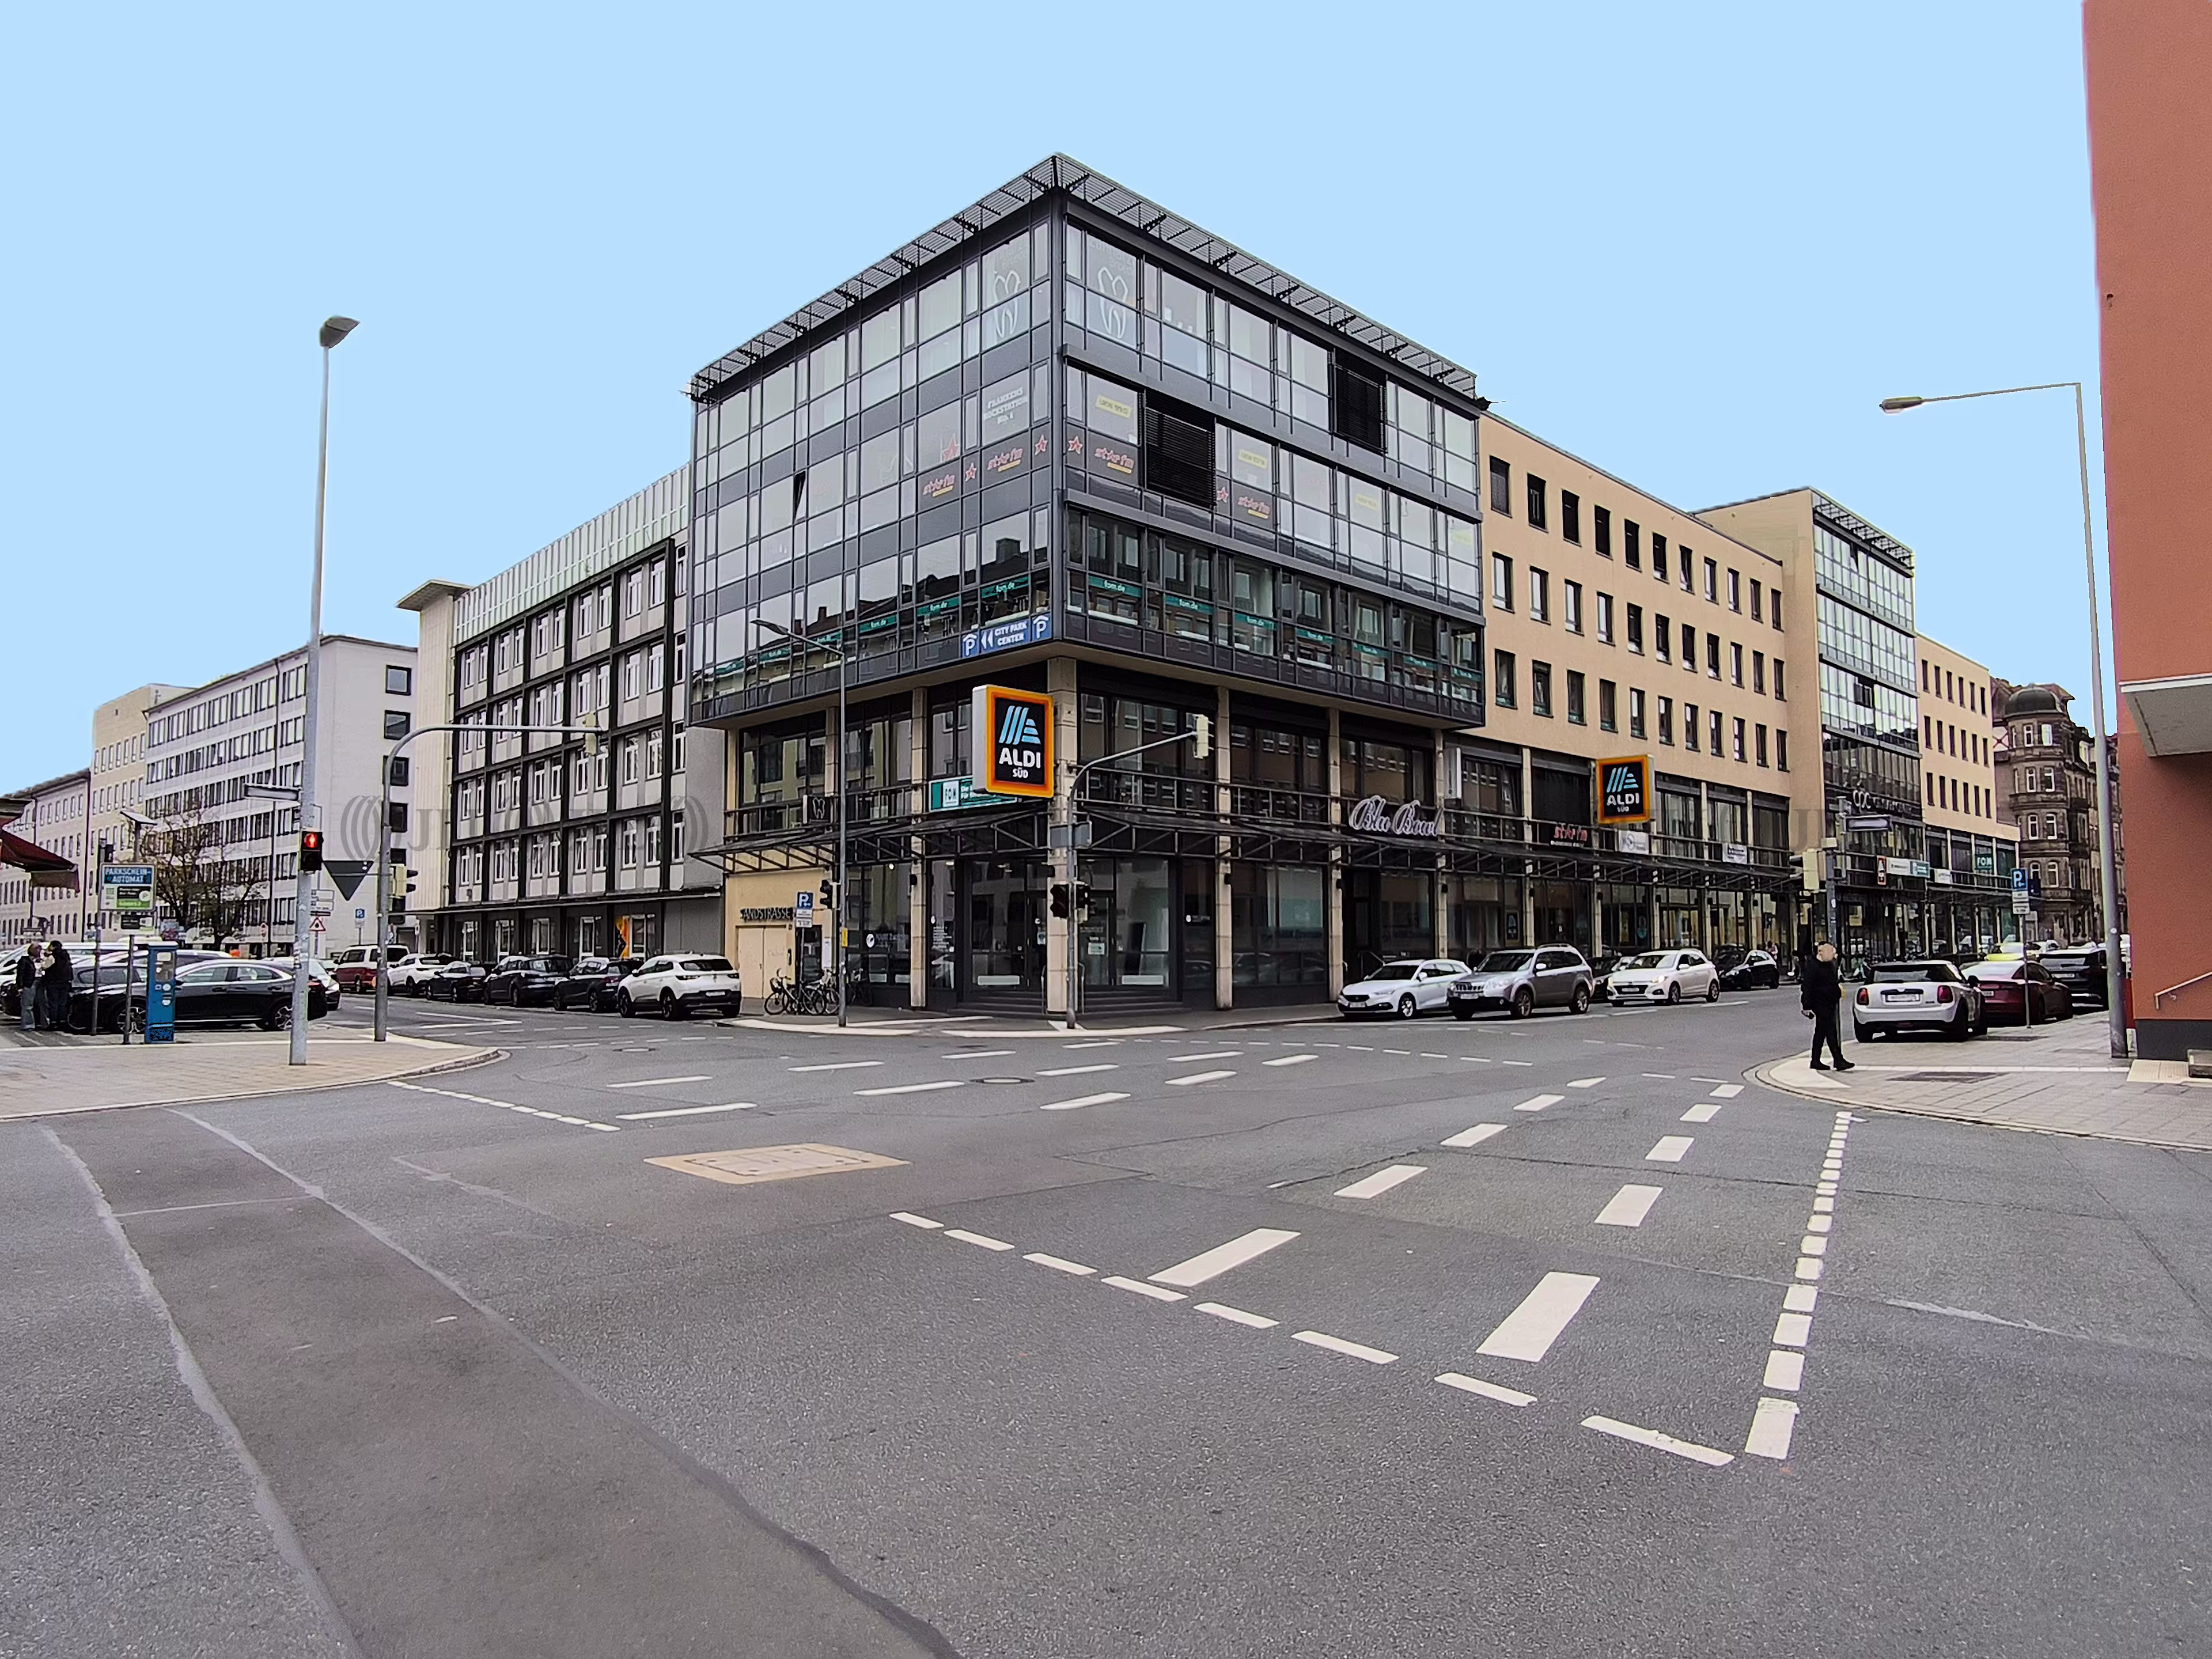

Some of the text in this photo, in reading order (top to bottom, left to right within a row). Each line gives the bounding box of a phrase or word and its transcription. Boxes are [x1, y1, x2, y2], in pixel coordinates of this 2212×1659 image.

[995, 620, 1028, 637] CITY PARK
[997, 632, 1024, 646] CENTER
[998, 747, 1041, 769] ALDI
[1012, 767, 1029, 779] SÜD
[945, 787, 957, 801] FOM
[1606, 792, 1640, 806] ALDI
[1391, 799, 1444, 836] Bowl
[1976, 856, 1993, 866] FOM
